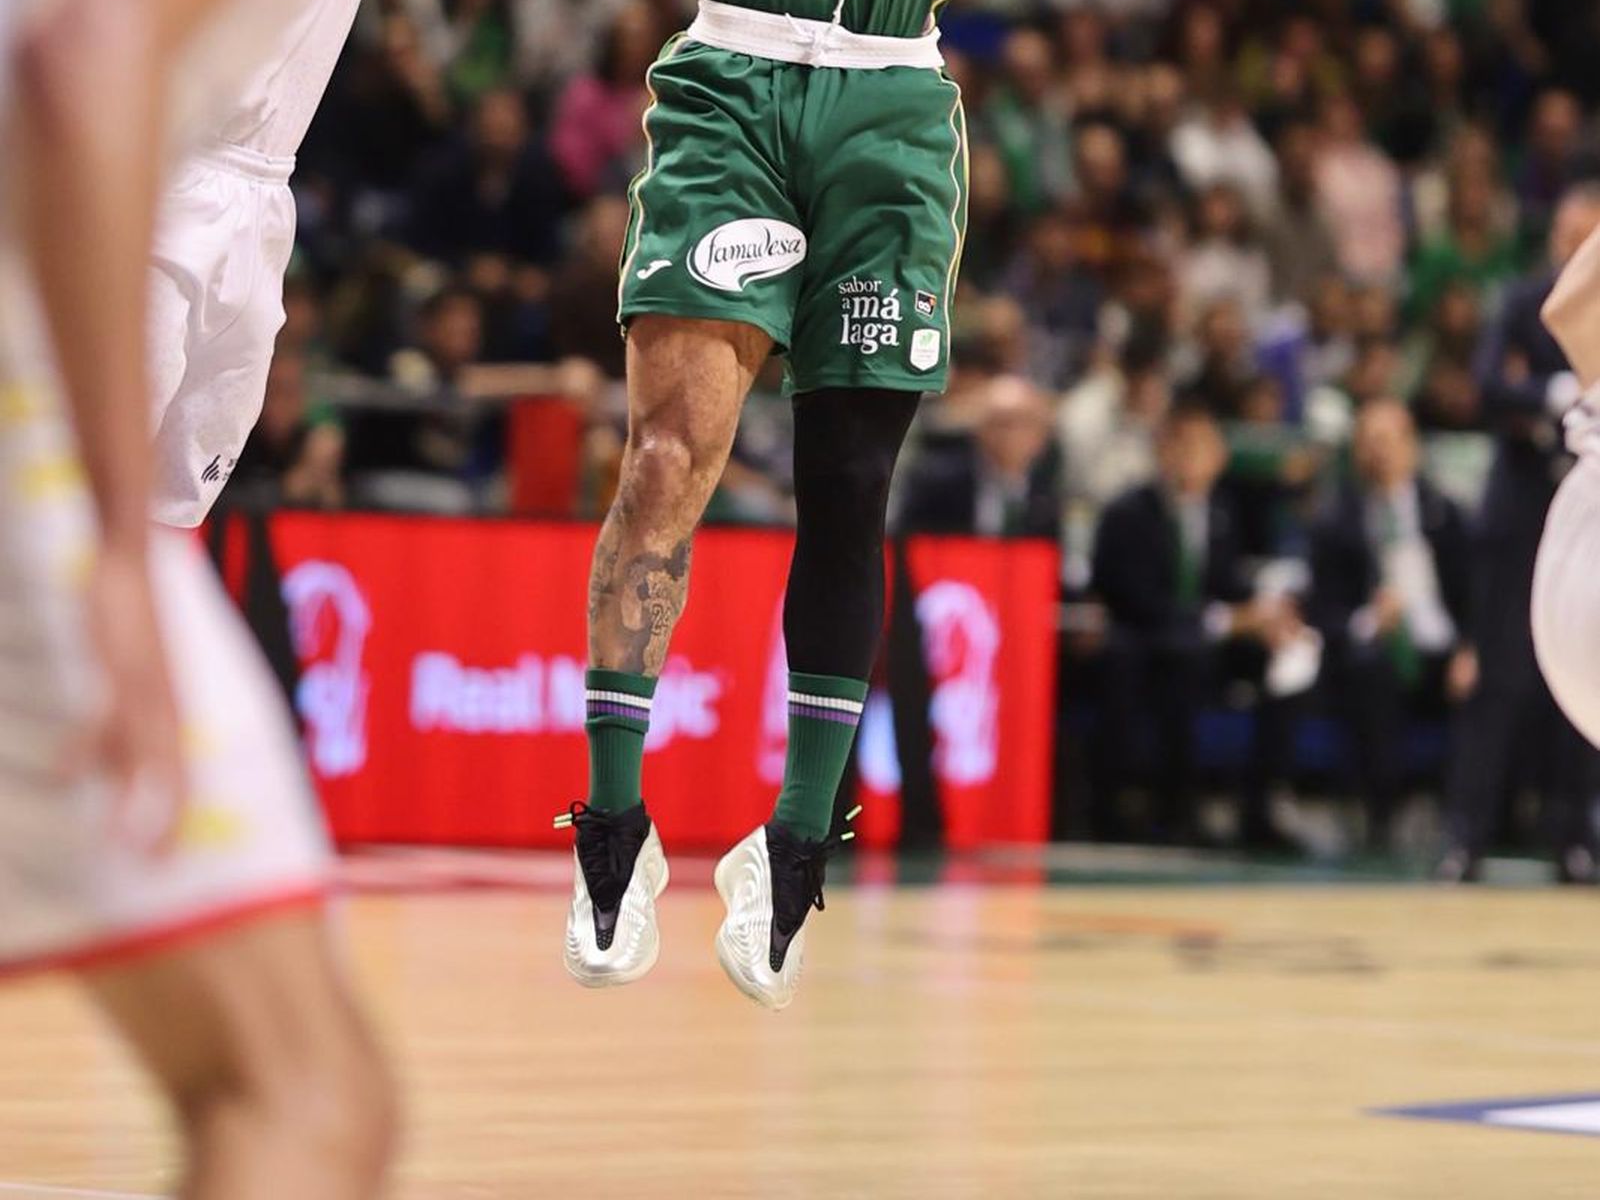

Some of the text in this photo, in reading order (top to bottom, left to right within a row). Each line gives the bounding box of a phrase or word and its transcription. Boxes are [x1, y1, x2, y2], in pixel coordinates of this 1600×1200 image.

[702, 226, 801, 275] famadesa
[838, 275, 882, 294] sabor
[842, 296, 850, 309] a
[851, 288, 903, 321] má
[841, 314, 899, 354] laga
